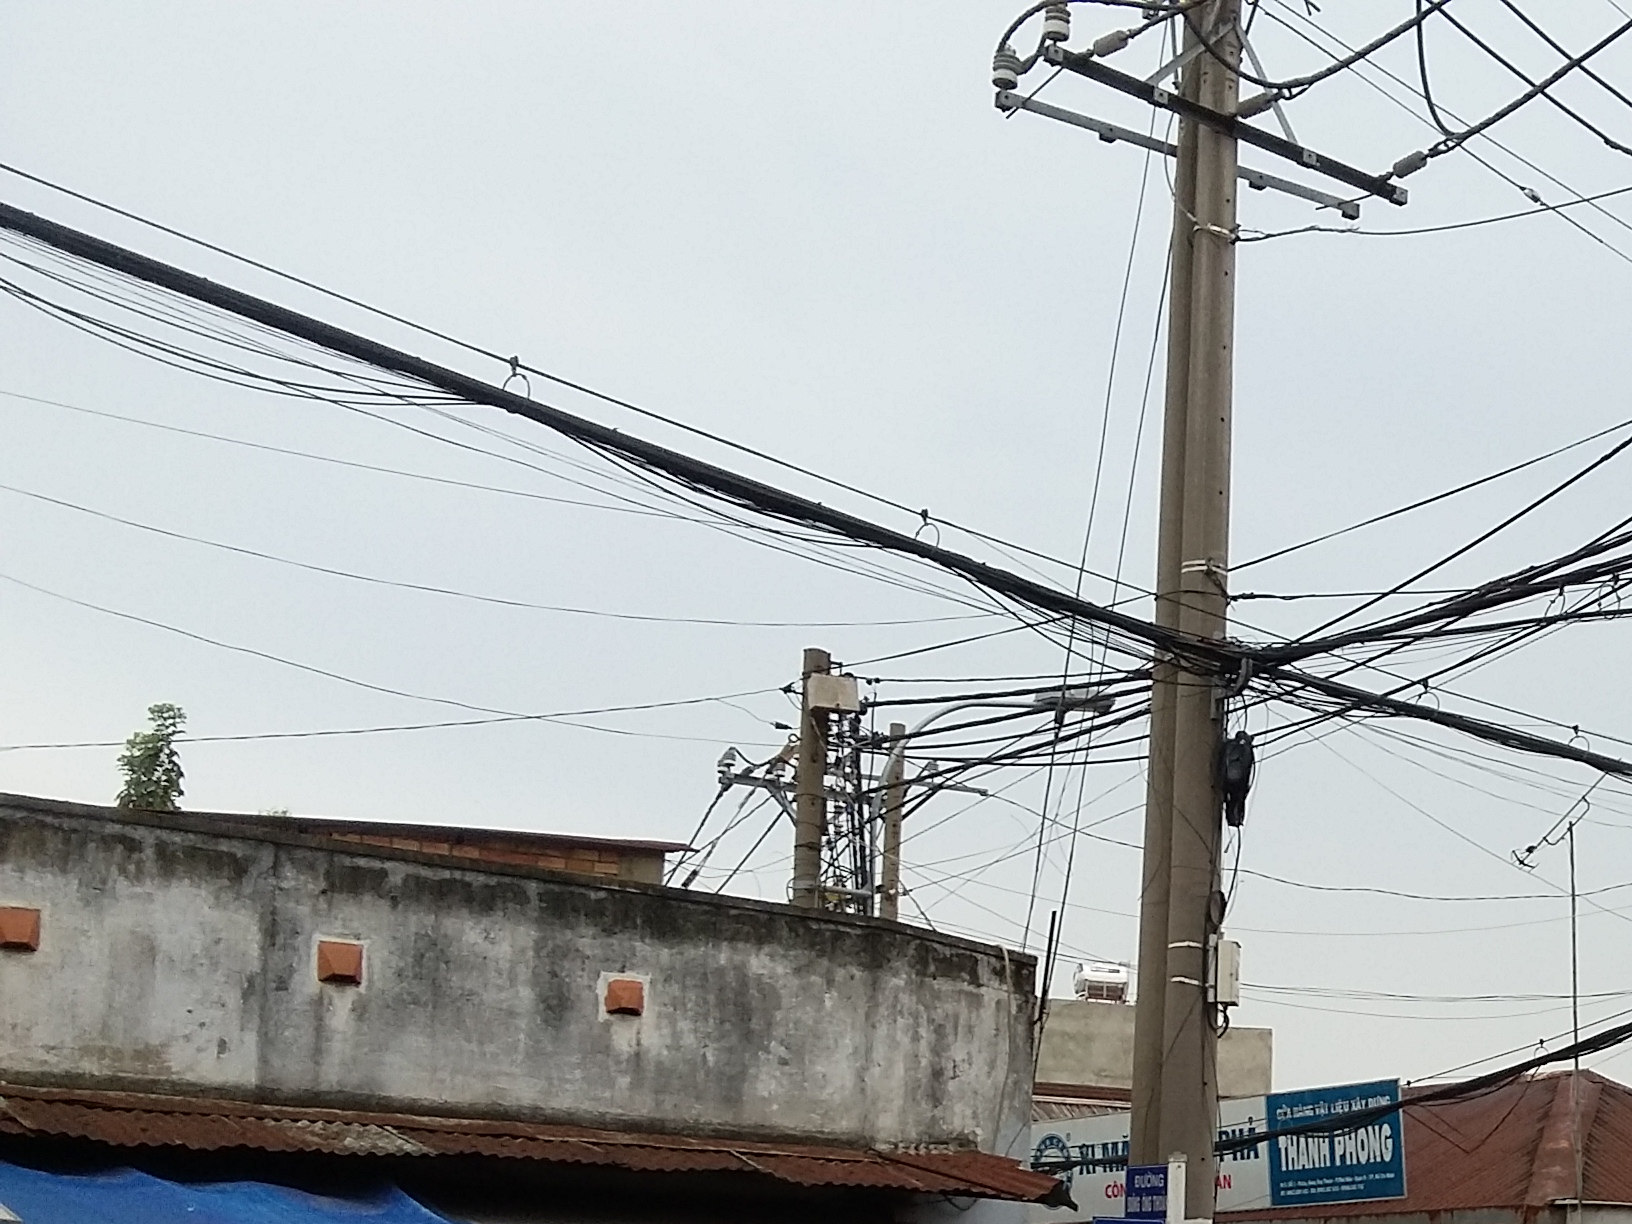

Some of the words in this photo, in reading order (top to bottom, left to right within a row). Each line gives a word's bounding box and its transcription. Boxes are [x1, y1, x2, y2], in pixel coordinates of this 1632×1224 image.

[1278, 1132, 1331, 1171] THANH
[1333, 1123, 1394, 1166] PHONG
[1134, 1171, 1165, 1188] ĐƯỜNG
